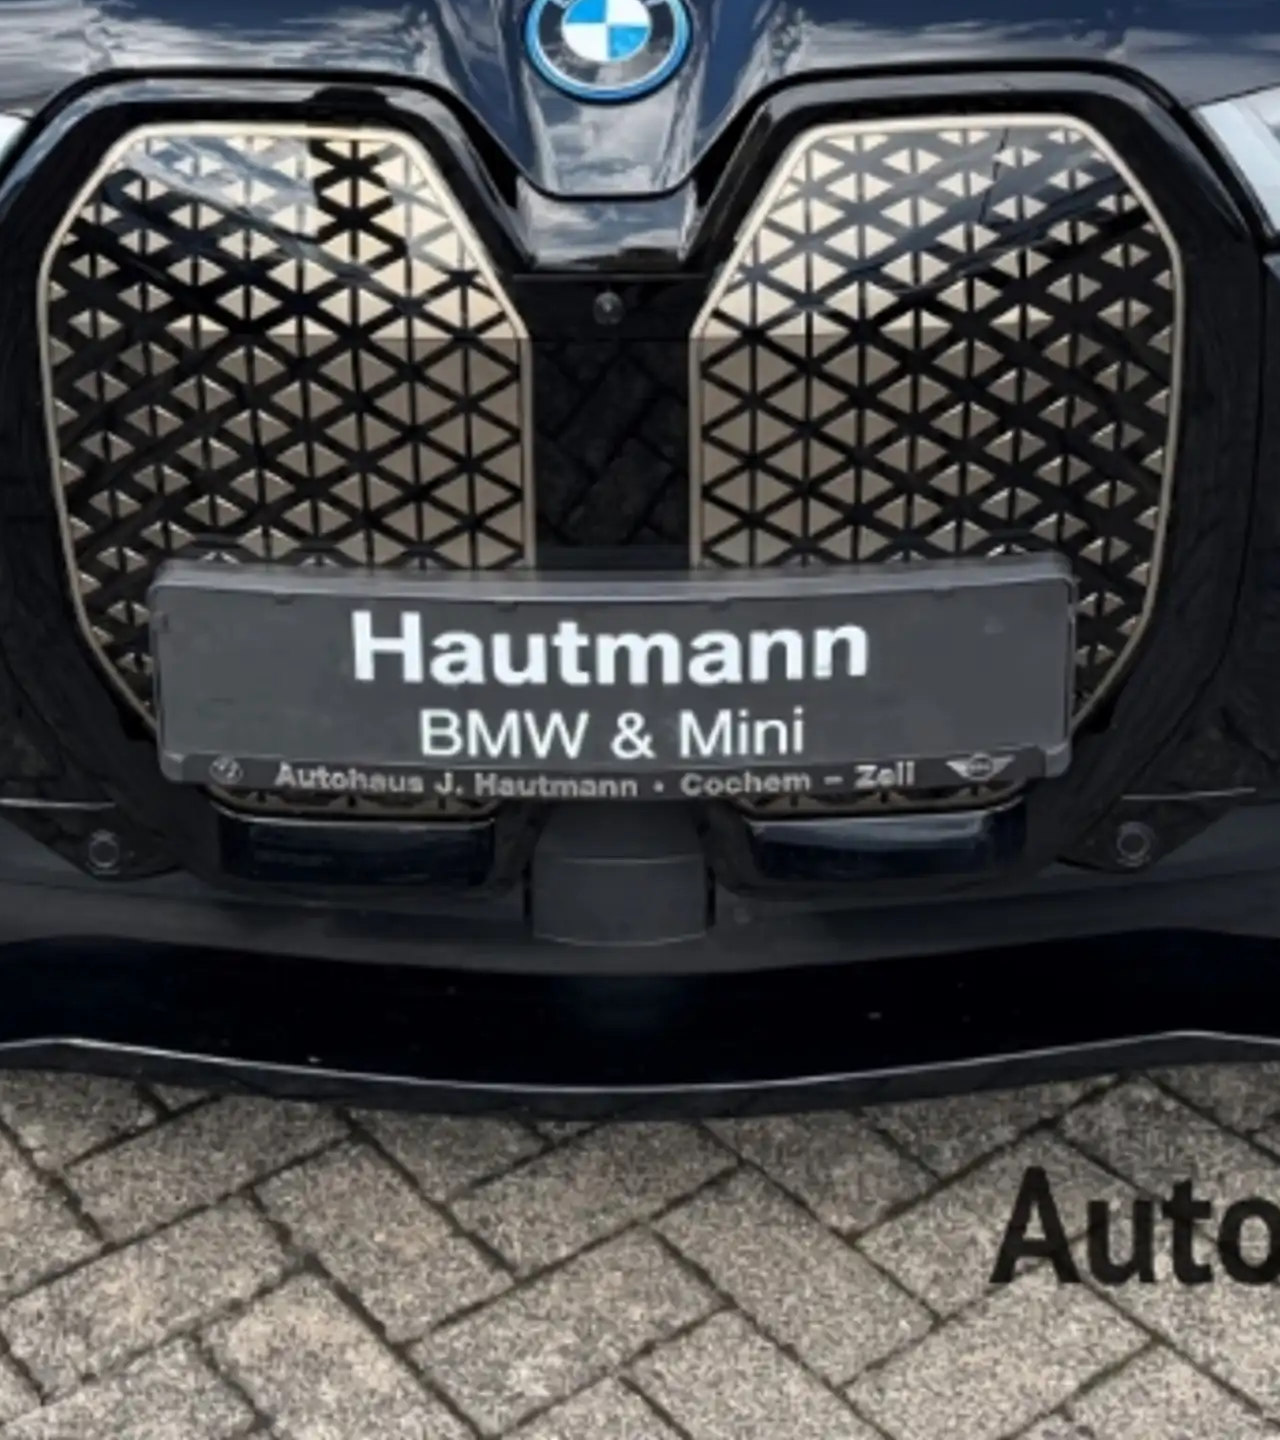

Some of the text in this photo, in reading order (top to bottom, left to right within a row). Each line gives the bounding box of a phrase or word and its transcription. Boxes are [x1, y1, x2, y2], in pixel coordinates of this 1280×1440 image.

[351, 609, 869, 686] Hautmann
[419, 706, 805, 760] BMW & Mini
[273, 760, 425, 794] Autohaus
[433, 771, 464, 797] J.
[474, 771, 638, 799] Hautmann
[680, 769, 812, 796] Cochem
[853, 761, 916, 790] Zell
